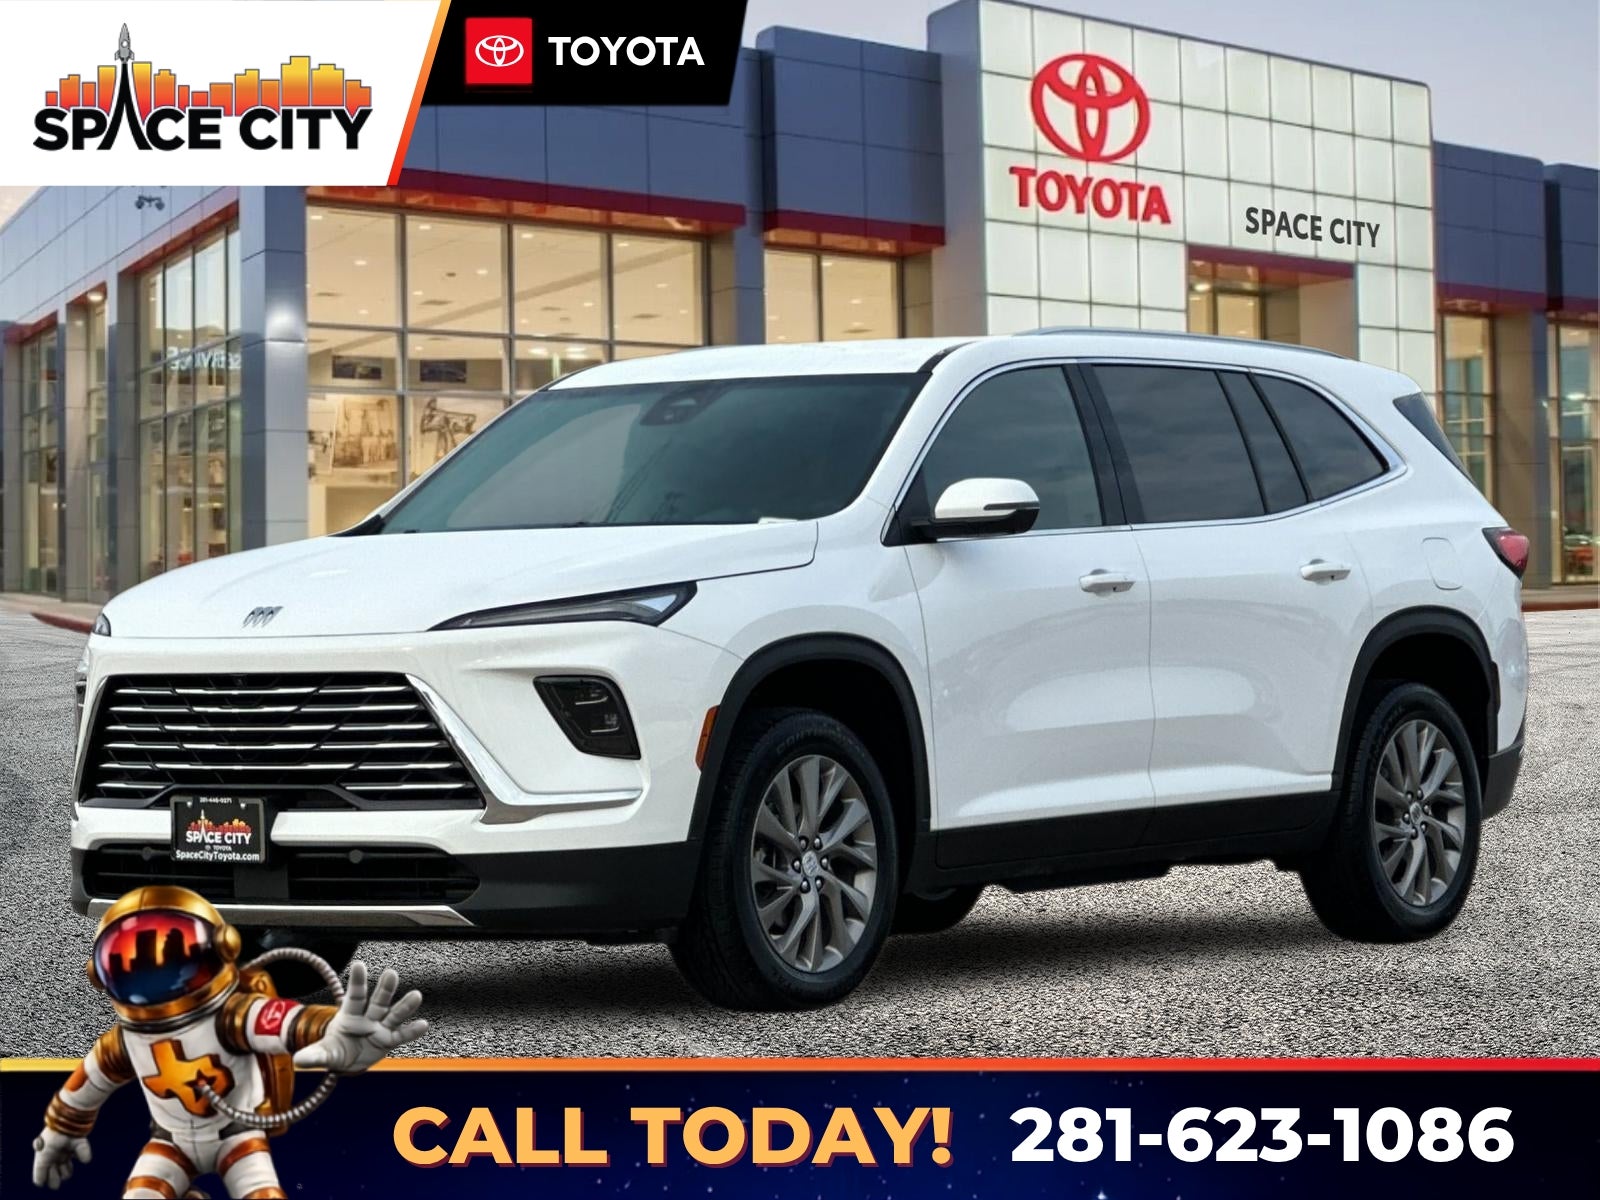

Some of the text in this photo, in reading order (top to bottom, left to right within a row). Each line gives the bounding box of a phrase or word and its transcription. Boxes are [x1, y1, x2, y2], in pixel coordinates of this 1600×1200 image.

[1009, 166, 1171, 224] TOYOTA
[1245, 206, 1380, 248] SPACE CITY
[186, 831, 252, 844] SPACE CITY
[176, 850, 260, 861] SpaceCityToyota.com
